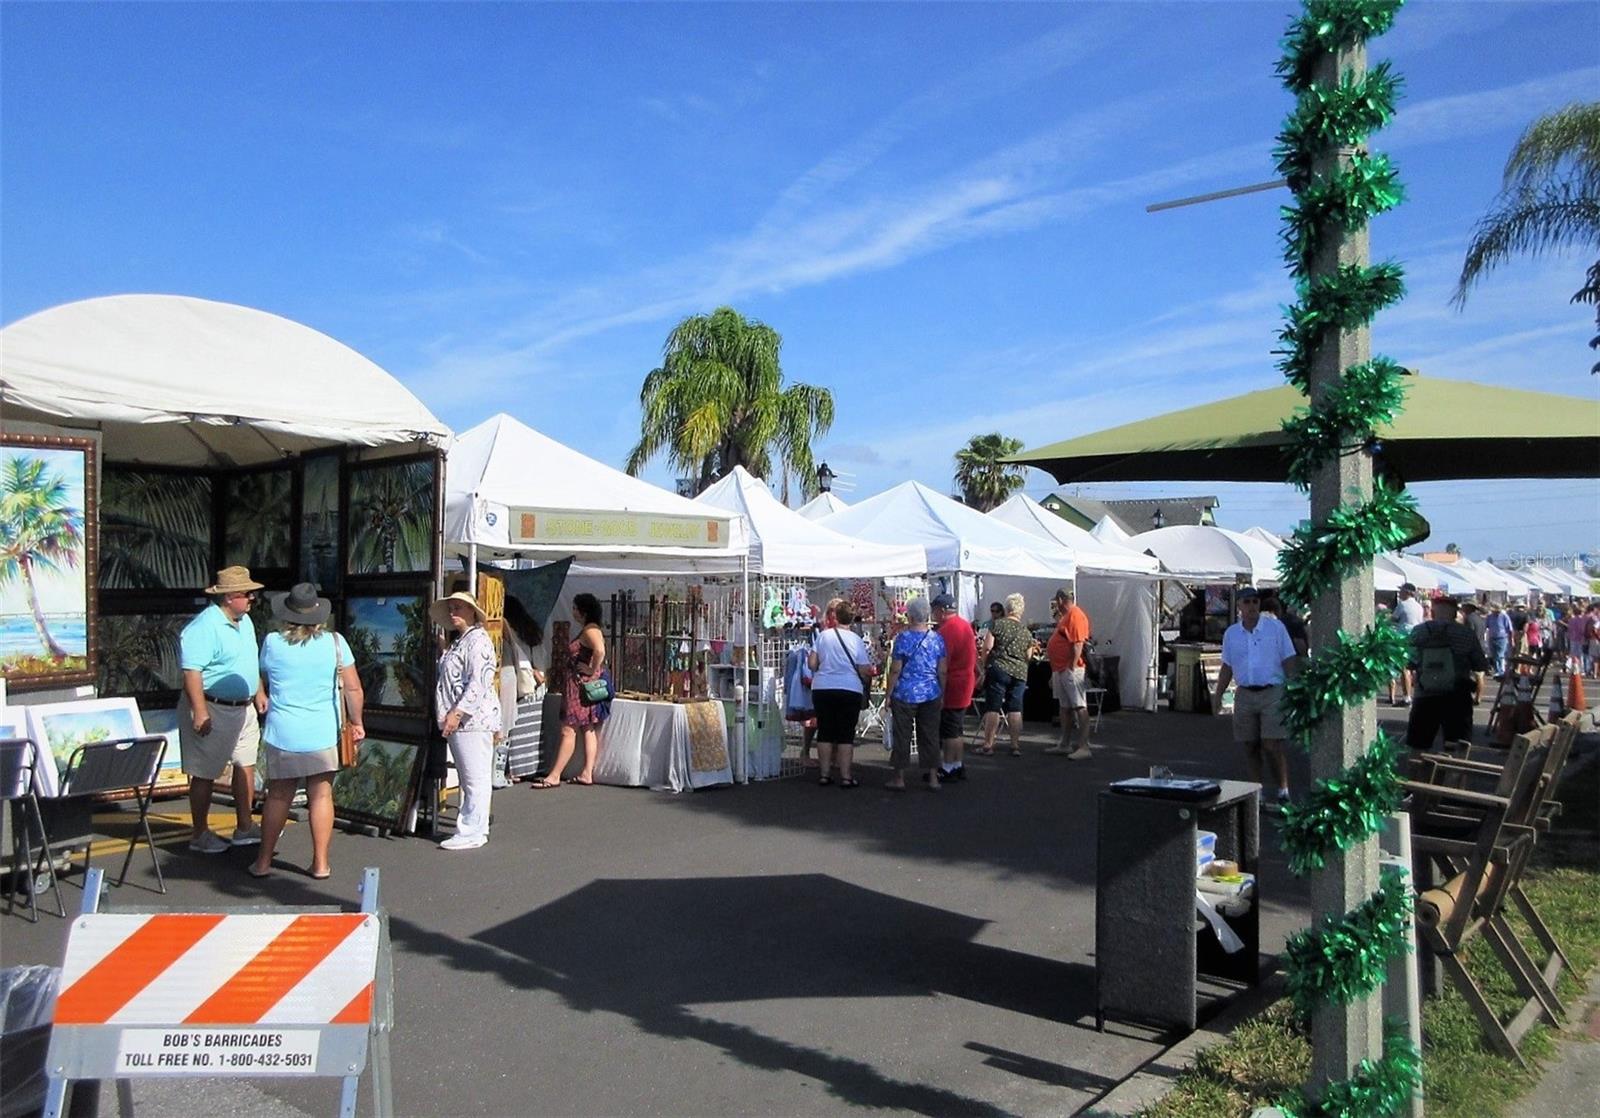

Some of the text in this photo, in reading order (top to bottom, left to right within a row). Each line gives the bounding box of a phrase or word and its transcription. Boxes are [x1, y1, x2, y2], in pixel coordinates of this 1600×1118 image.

[163, 1034, 283, 1047] BOB'S BARRICADES
[125, 1053, 312, 1066] TOLL FREE NO. 1-800-432-5031
